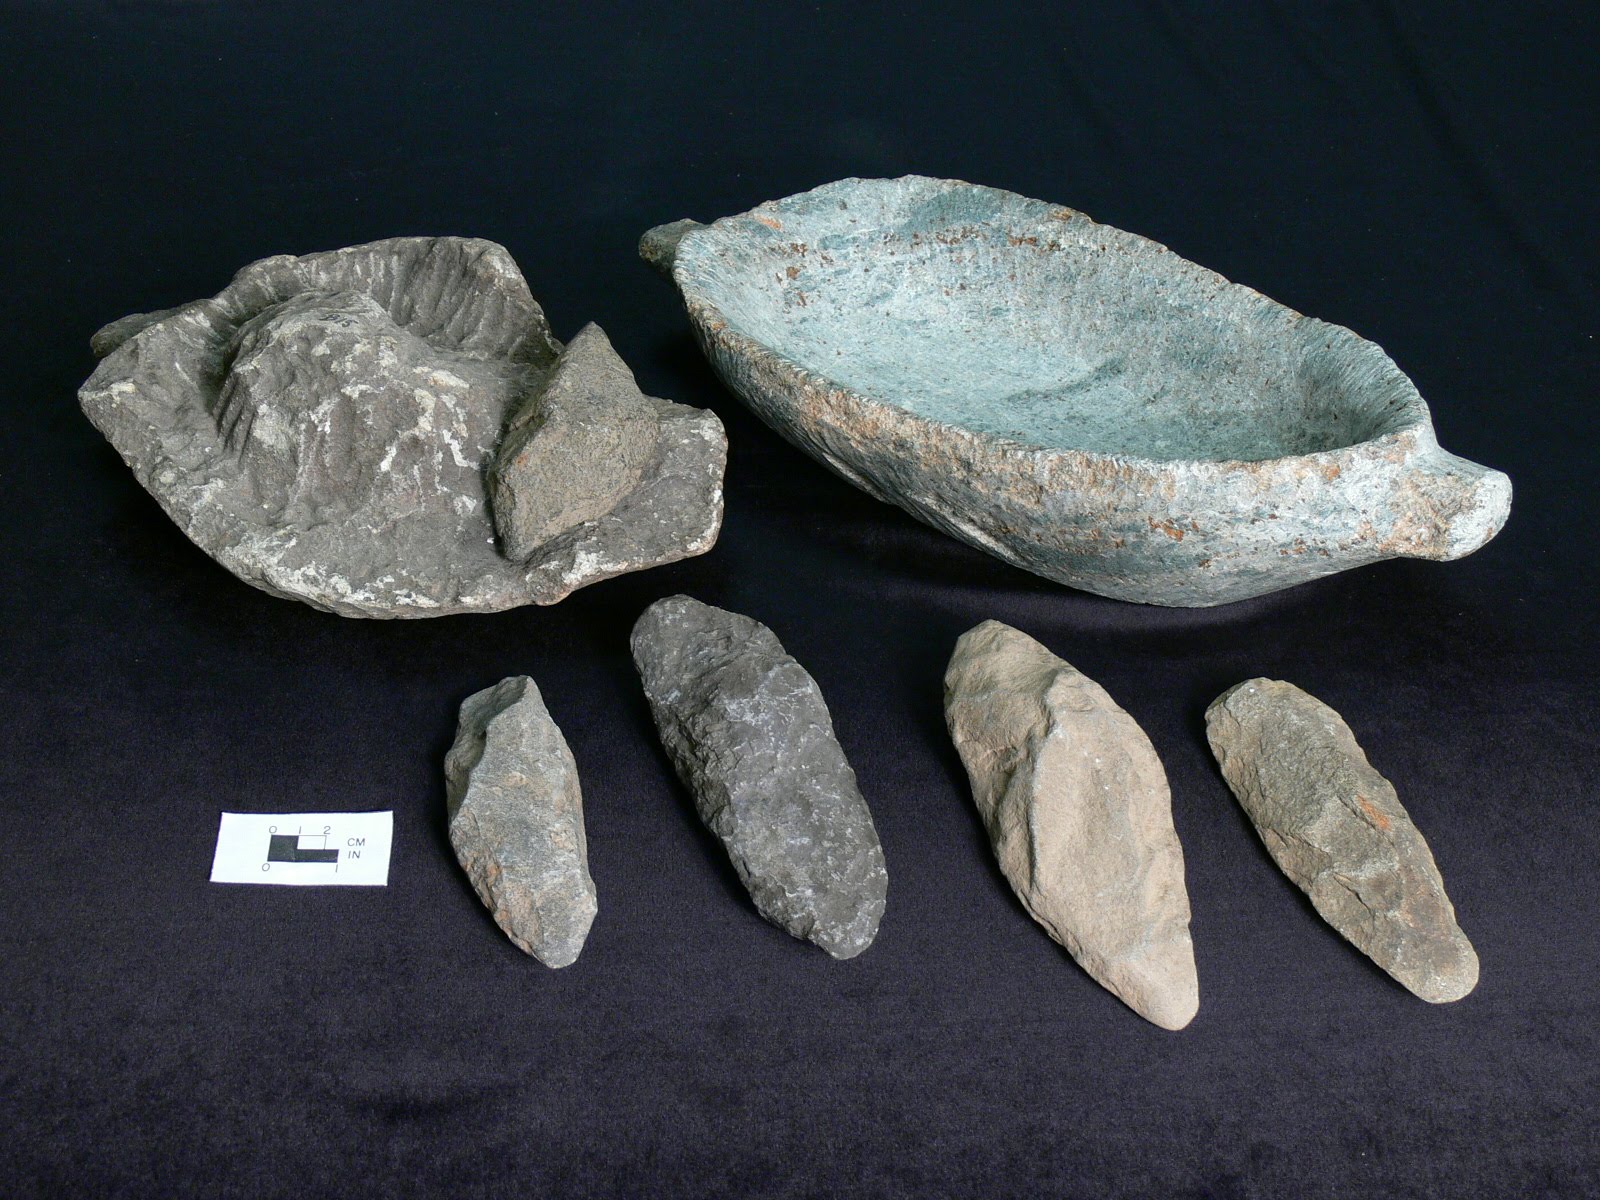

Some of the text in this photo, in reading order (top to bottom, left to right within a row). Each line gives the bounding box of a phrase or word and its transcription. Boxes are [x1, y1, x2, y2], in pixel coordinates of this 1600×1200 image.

[268, 825, 278, 834] 0
[323, 825, 331, 835] 2
[347, 837, 366, 847] CM
[347, 850, 361, 859] IN
[261, 862, 271, 872] 0
